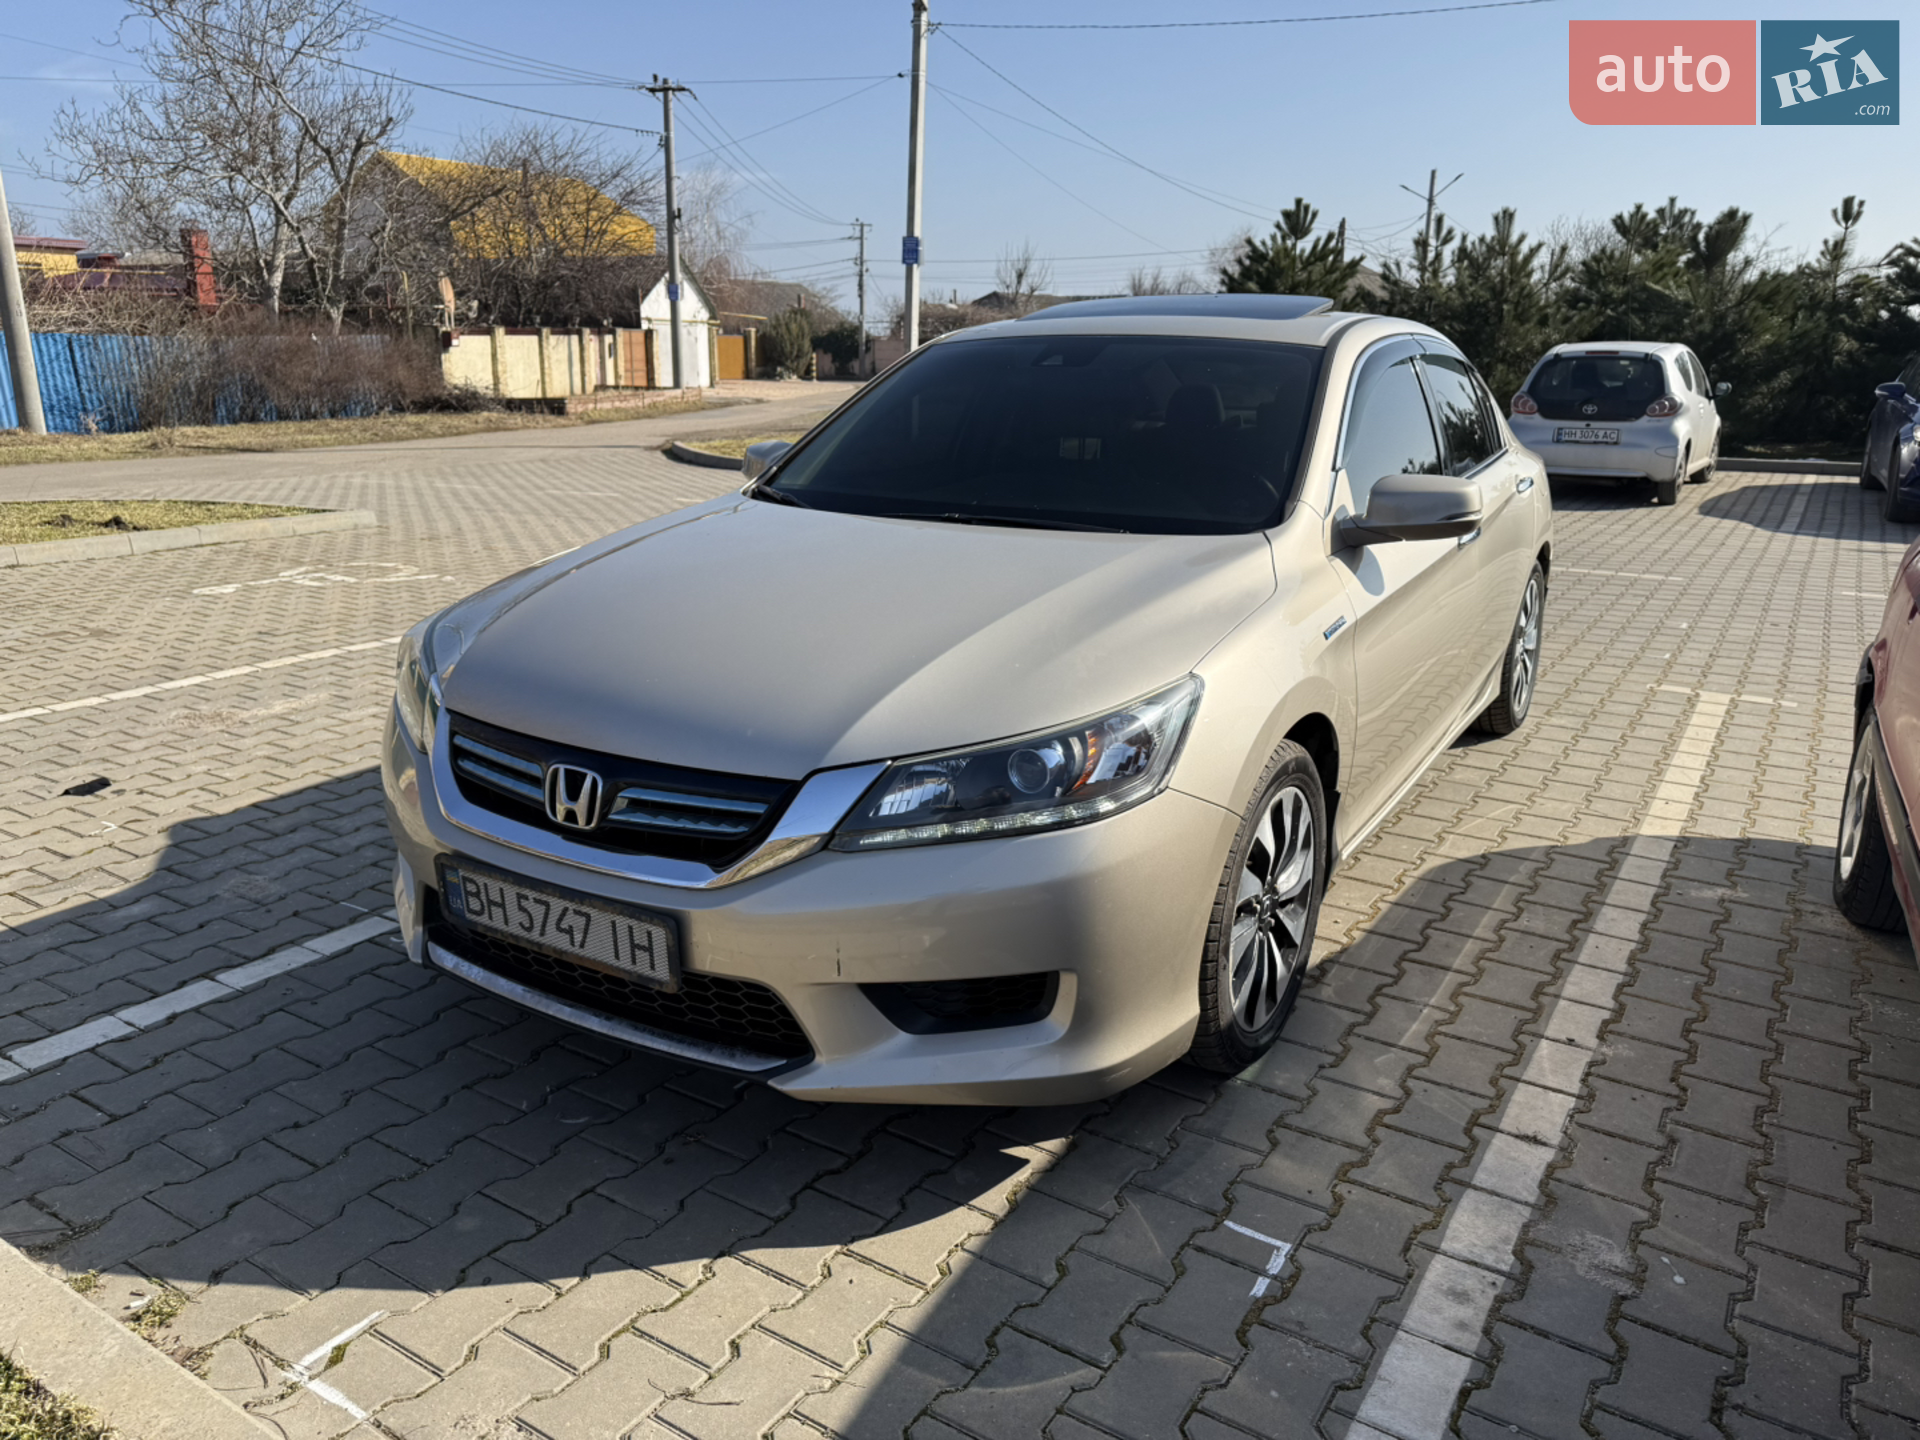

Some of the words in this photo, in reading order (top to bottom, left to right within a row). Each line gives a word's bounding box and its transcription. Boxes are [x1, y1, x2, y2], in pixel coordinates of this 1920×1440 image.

[1563, 430, 1577, 438] HH
[1579, 430, 1600, 440] 3076
[1602, 431, 1616, 441] AC
[461, 875, 509, 926] BH
[516, 892, 591, 949] 5747
[611, 919, 656, 971] IH
